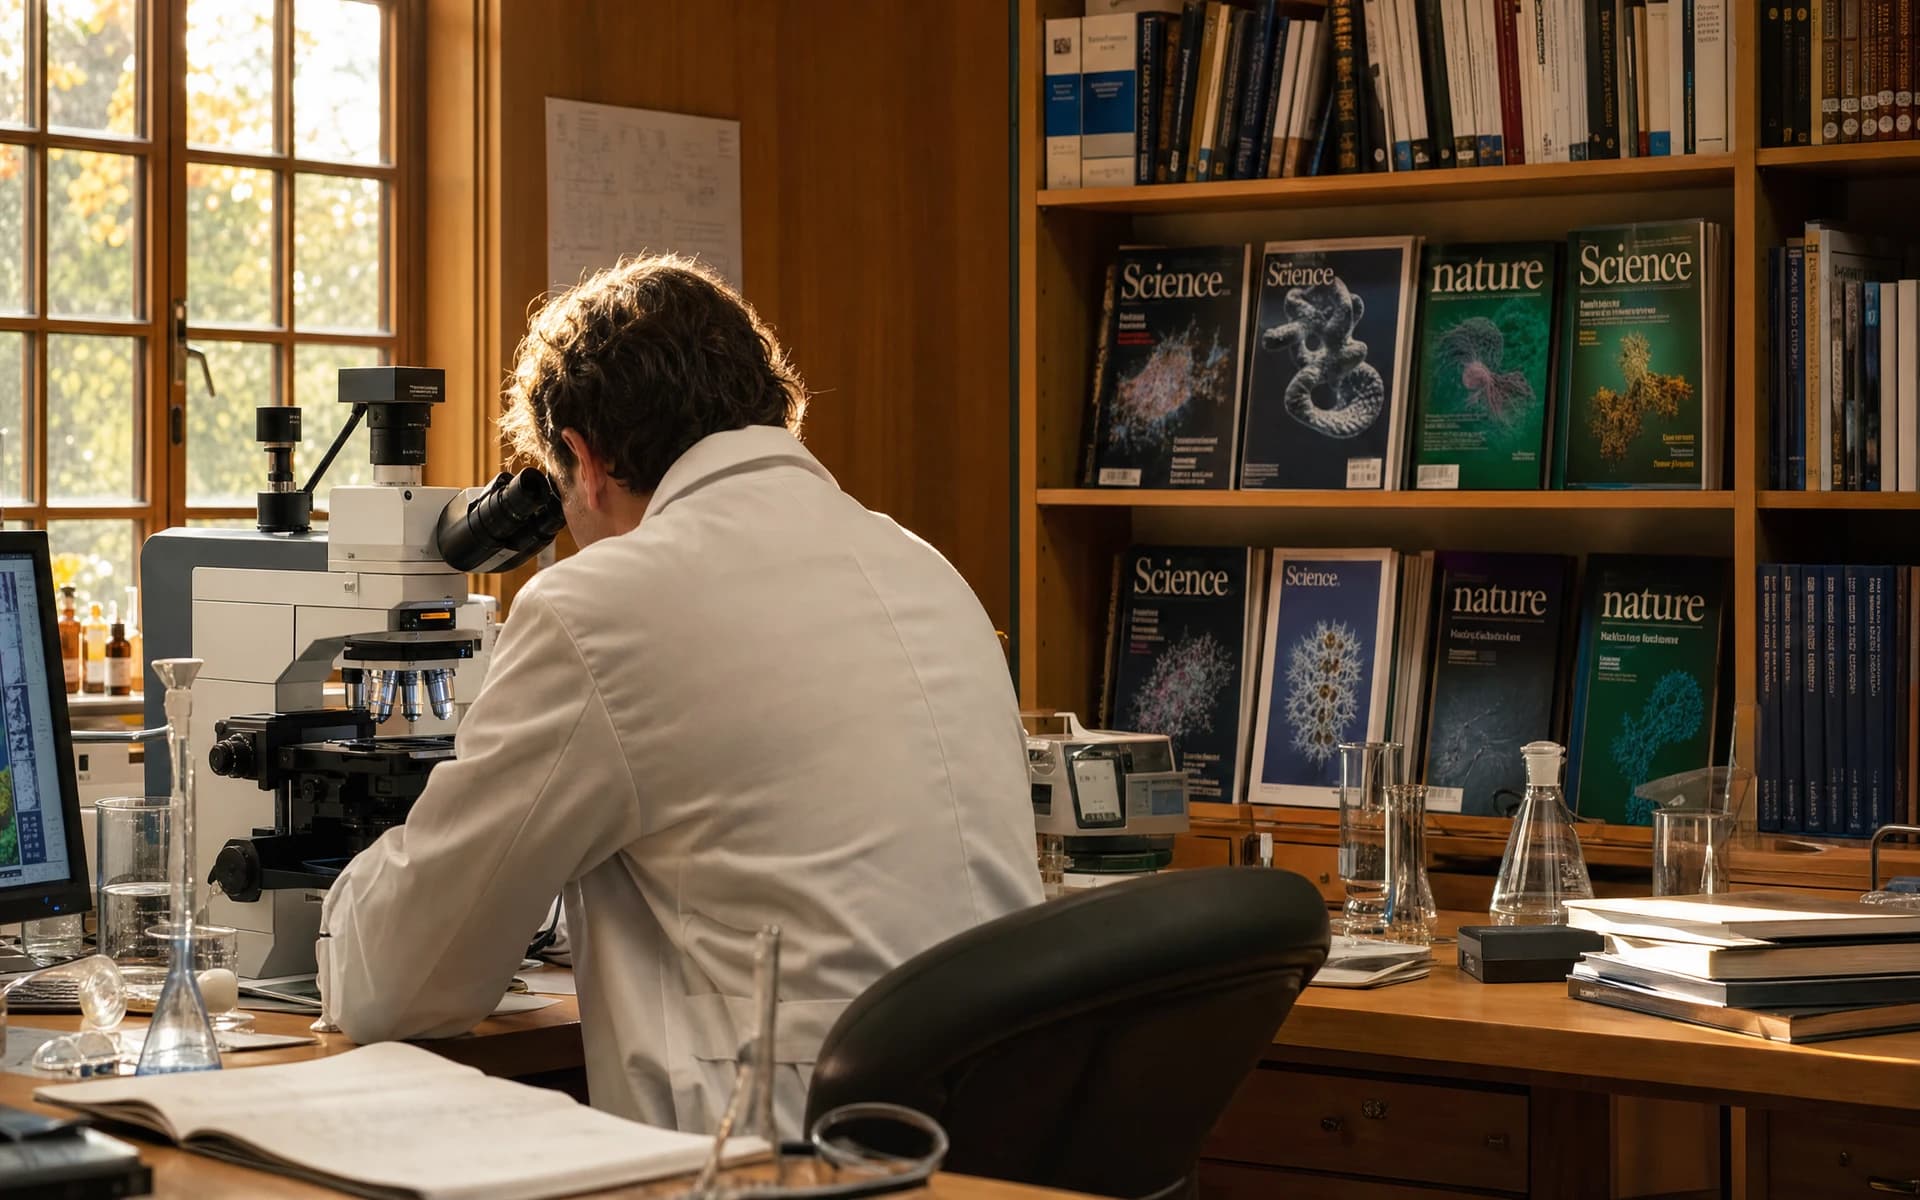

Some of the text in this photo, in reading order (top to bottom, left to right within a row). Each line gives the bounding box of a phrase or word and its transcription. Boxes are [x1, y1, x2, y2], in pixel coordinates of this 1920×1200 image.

[1121, 263, 1223, 299] Science
[1267, 261, 1334, 287] Science
[1431, 257, 1544, 293] nature
[1579, 243, 1692, 286] Science
[1133, 556, 1229, 596] Science
[1285, 565, 1338, 587] Science
[1452, 583, 1547, 616] nature
[1601, 587, 1705, 622] nature
